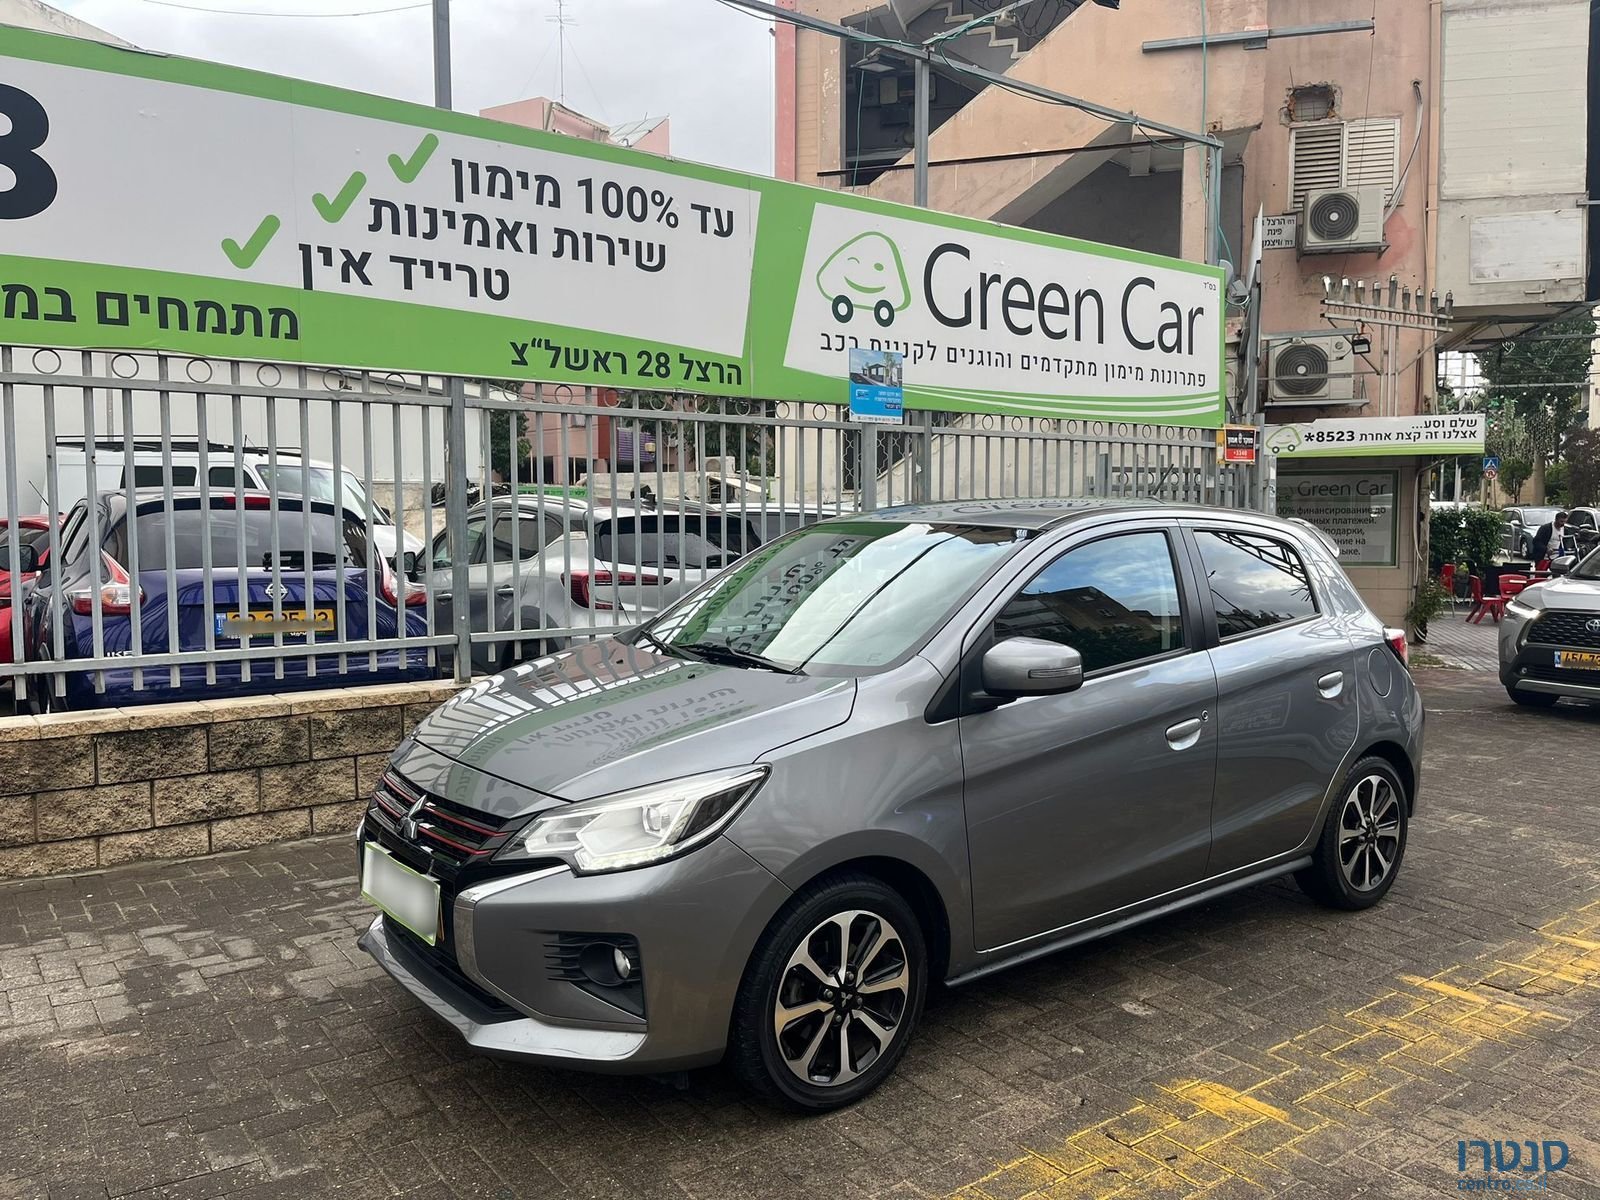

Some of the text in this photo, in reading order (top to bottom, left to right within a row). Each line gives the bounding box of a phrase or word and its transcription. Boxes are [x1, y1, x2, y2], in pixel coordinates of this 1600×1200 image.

[451, 158, 734, 238] עד 100% מימון
[368, 197, 666, 273] שירות ואמינות
[299, 242, 510, 301] טרייד אין
[923, 242, 1205, 356] Green Car
[96, 290, 299, 341] מתמחים
[637, 350, 671, 379] 28
[679, 353, 743, 385] הרצל
[946, 346, 1012, 369] והוגנים
[1021, 354, 1097, 379] מתקדמים
[1104, 363, 1144, 383] מימון
[1150, 368, 1206, 387] פתרונות
[1359, 428, 1477, 443] אצלנו זה קצת אחרת
[1449, 417, 1477, 428] שלם
[1297, 479, 1388, 497] Green Car
